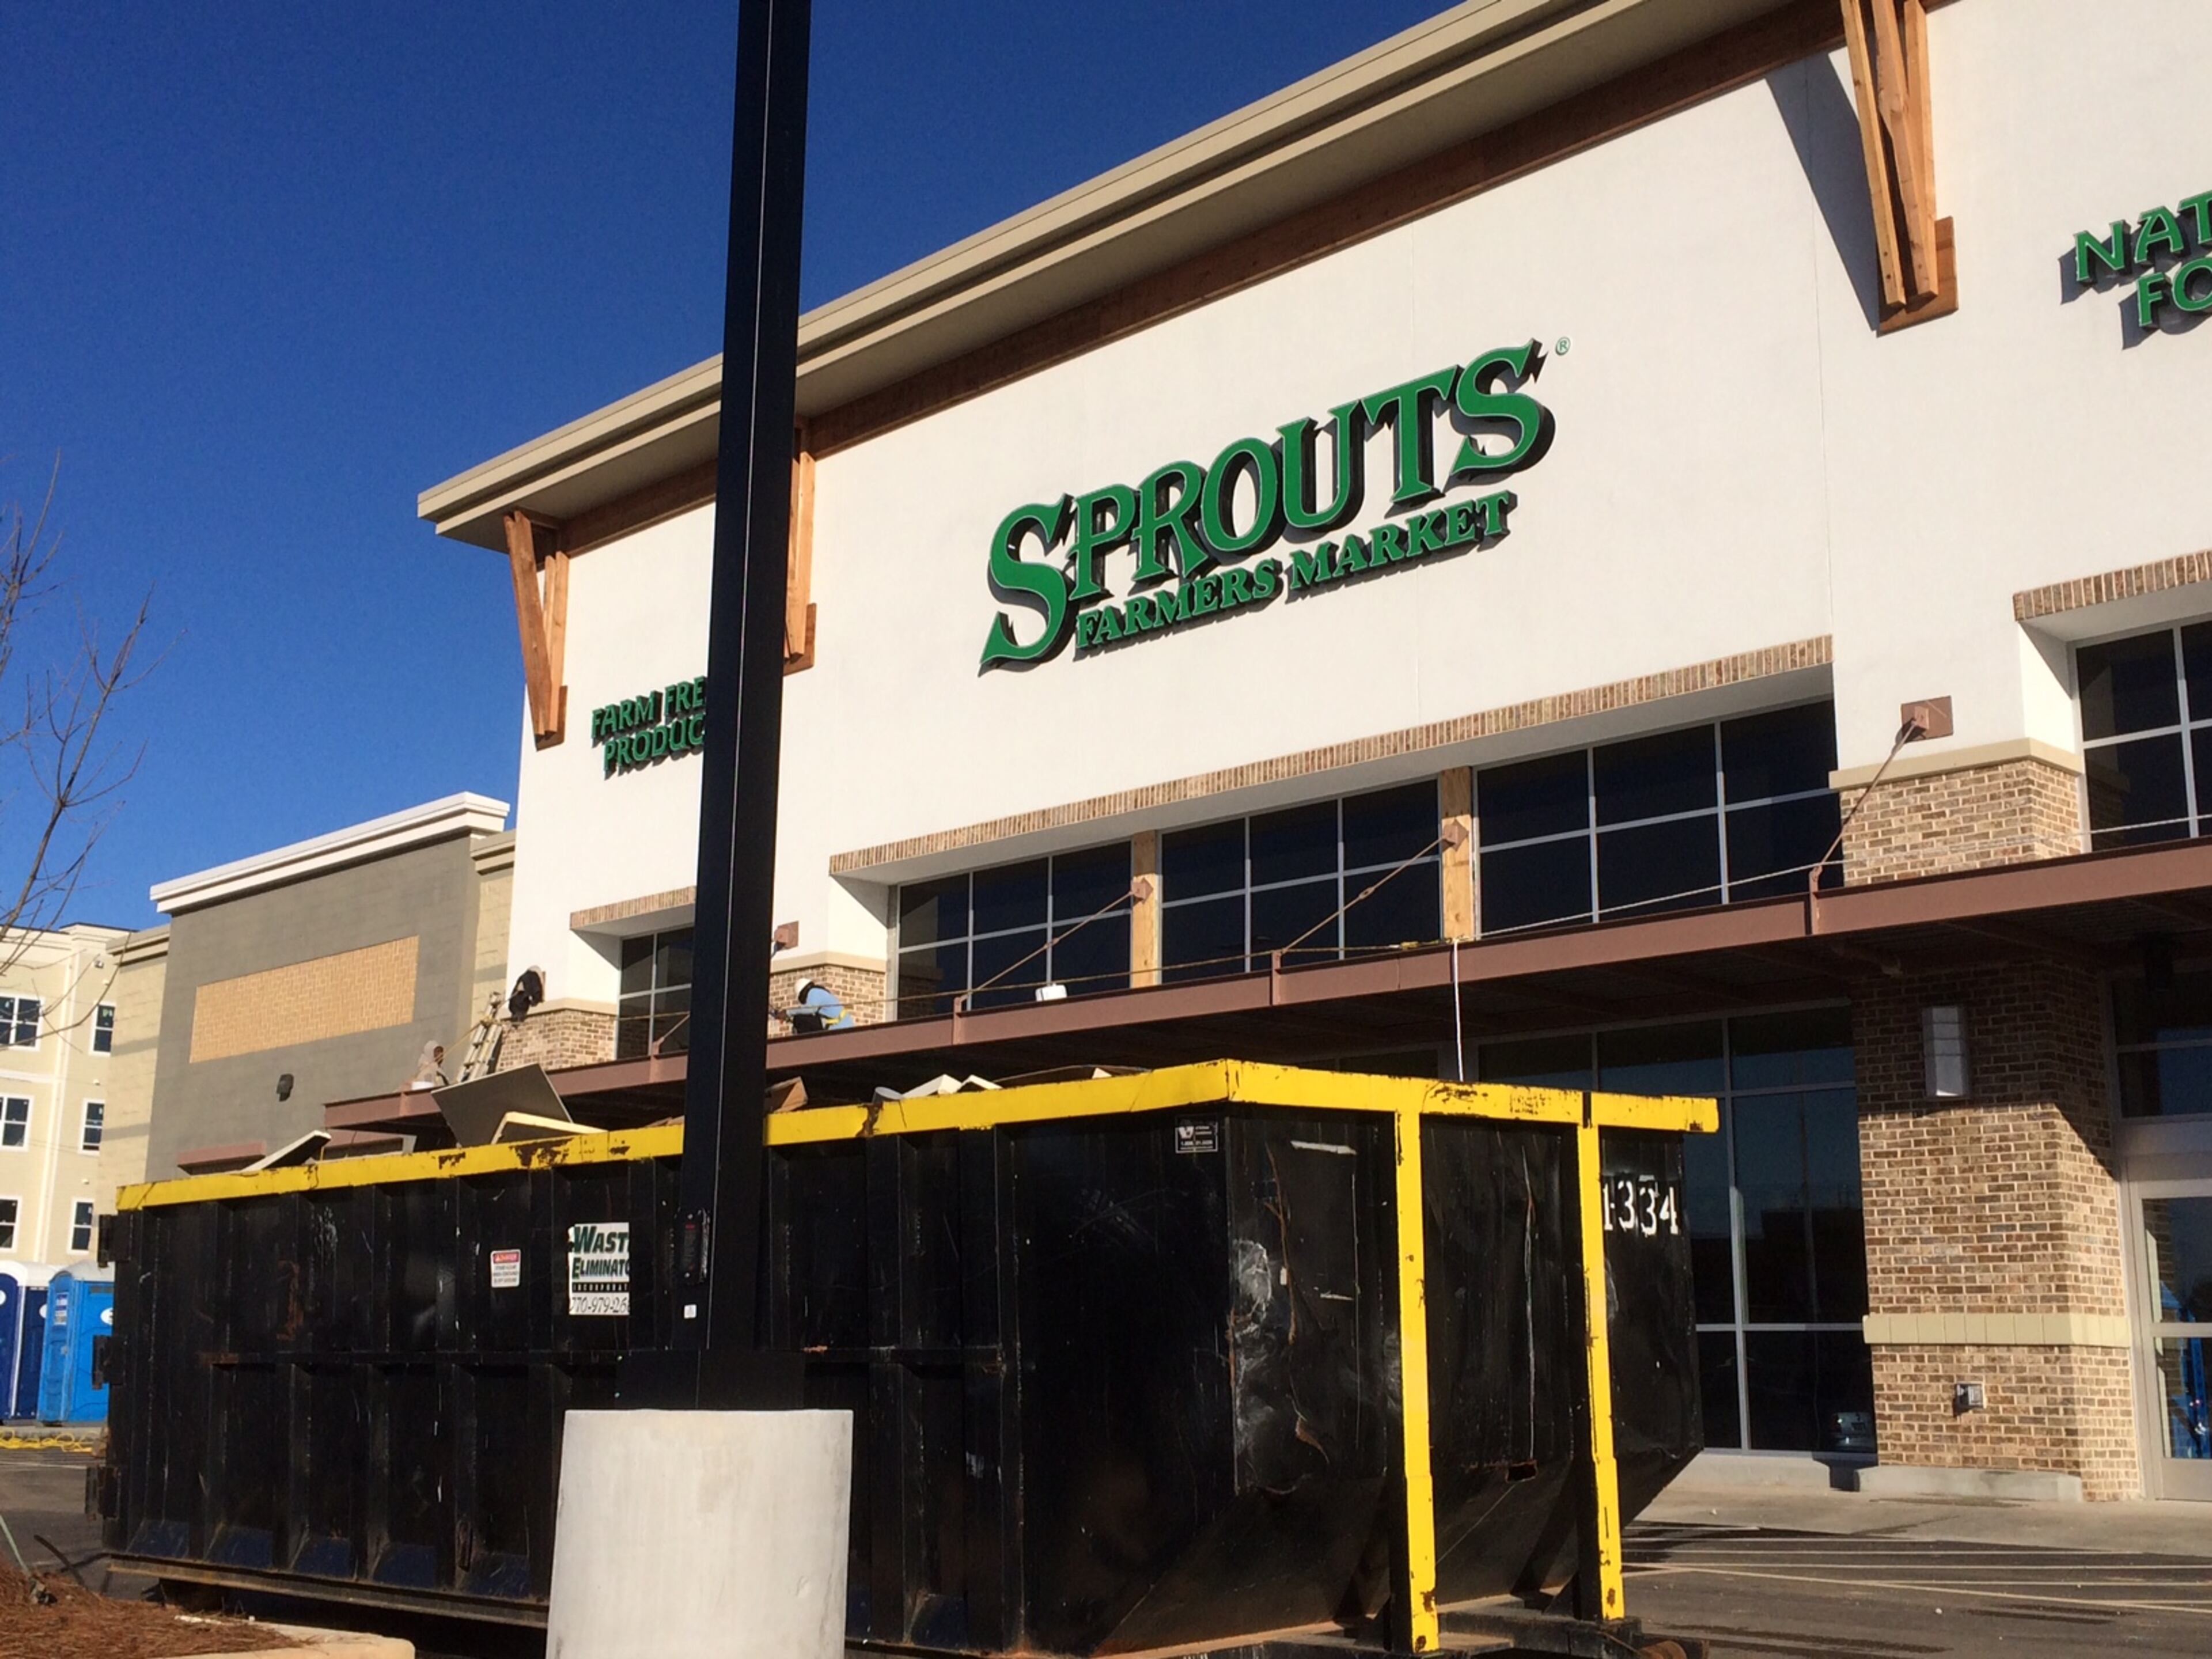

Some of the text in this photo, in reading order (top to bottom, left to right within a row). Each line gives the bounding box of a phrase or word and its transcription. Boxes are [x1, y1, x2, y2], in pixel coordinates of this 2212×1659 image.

[2073, 190, 2212, 281] NAT
[2137, 256, 2212, 327] FO
[979, 338, 1554, 666] SPROUTS
[1075, 490, 1516, 650] FARMERS MARKET
[591, 675, 707, 740] FARM FRE
[603, 713, 705, 772] PRODUC
[574, 1226, 629, 1253] WAST
[570, 1297, 630, 1313] 770-979-26
